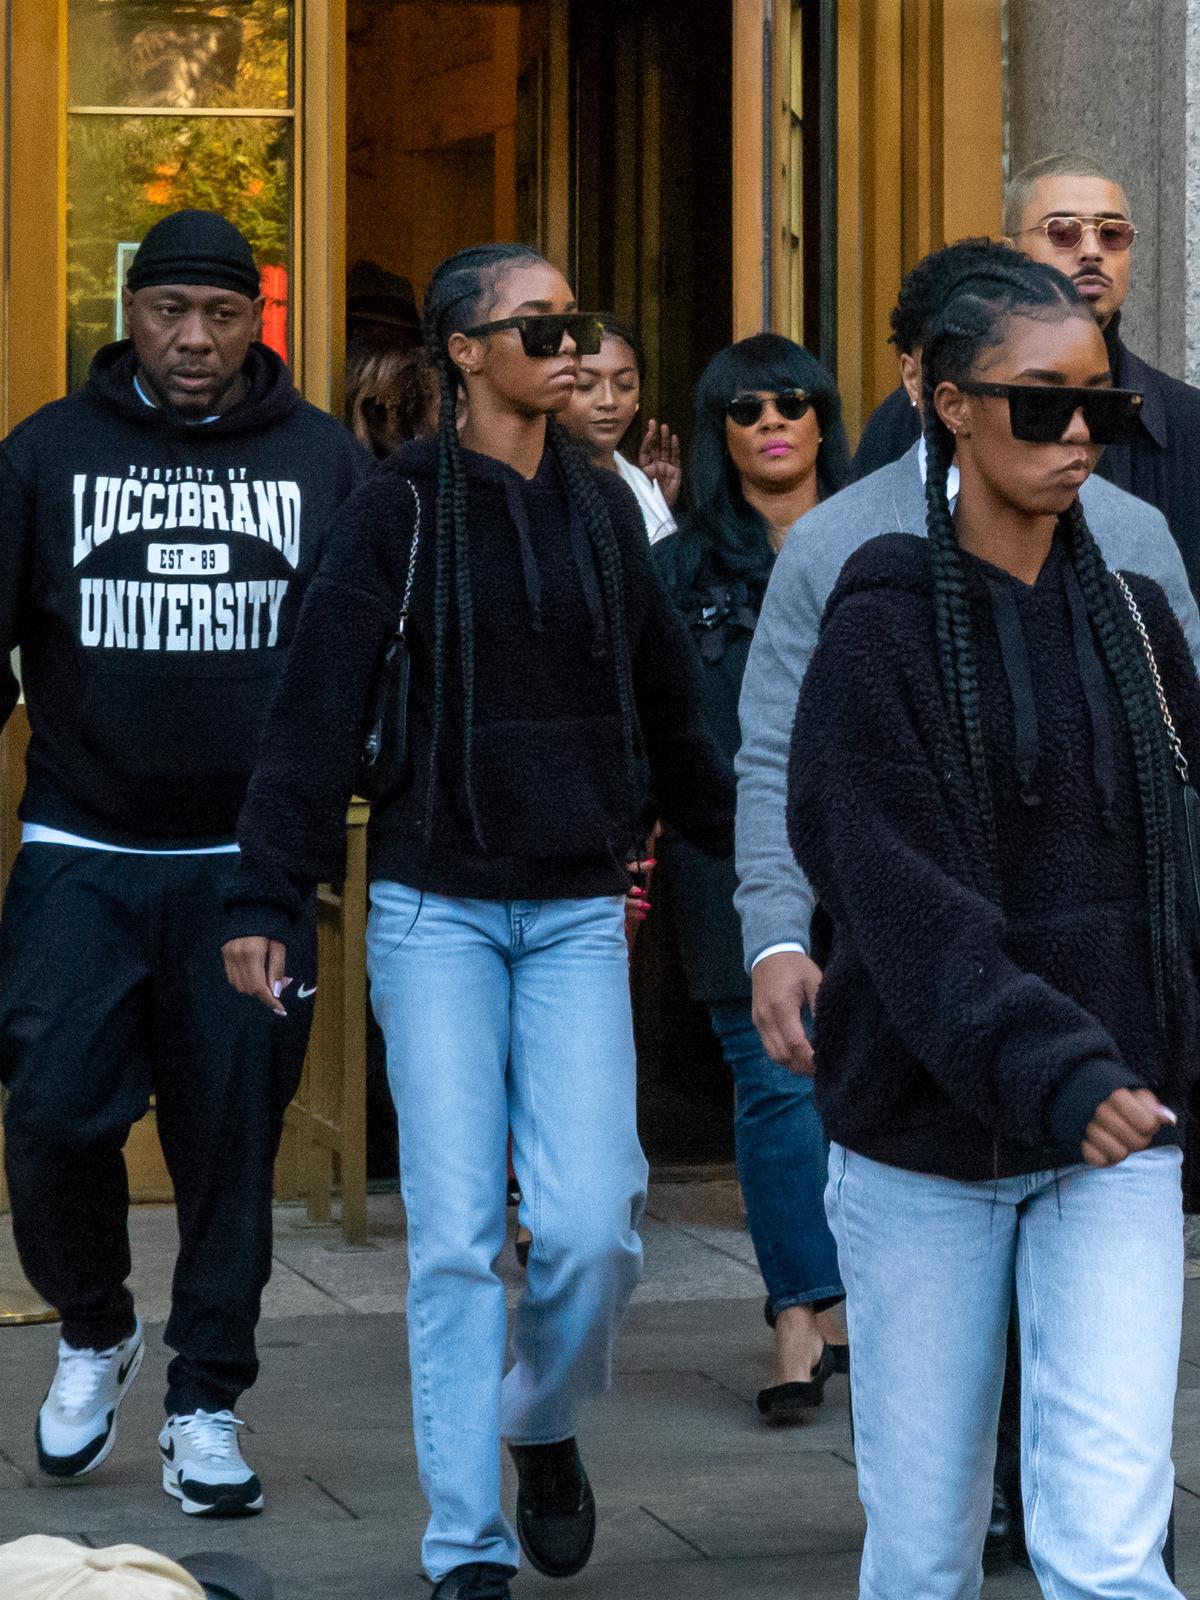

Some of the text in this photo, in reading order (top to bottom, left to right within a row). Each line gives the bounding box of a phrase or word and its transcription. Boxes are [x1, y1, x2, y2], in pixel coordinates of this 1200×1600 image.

[129, 464, 246, 482] PROPERTY OF
[73, 474, 301, 570] LUCCIBRAND
[160, 549, 183, 570] EST
[201, 549, 216, 570] 89
[80, 578, 289, 651] UNIVERSITY
